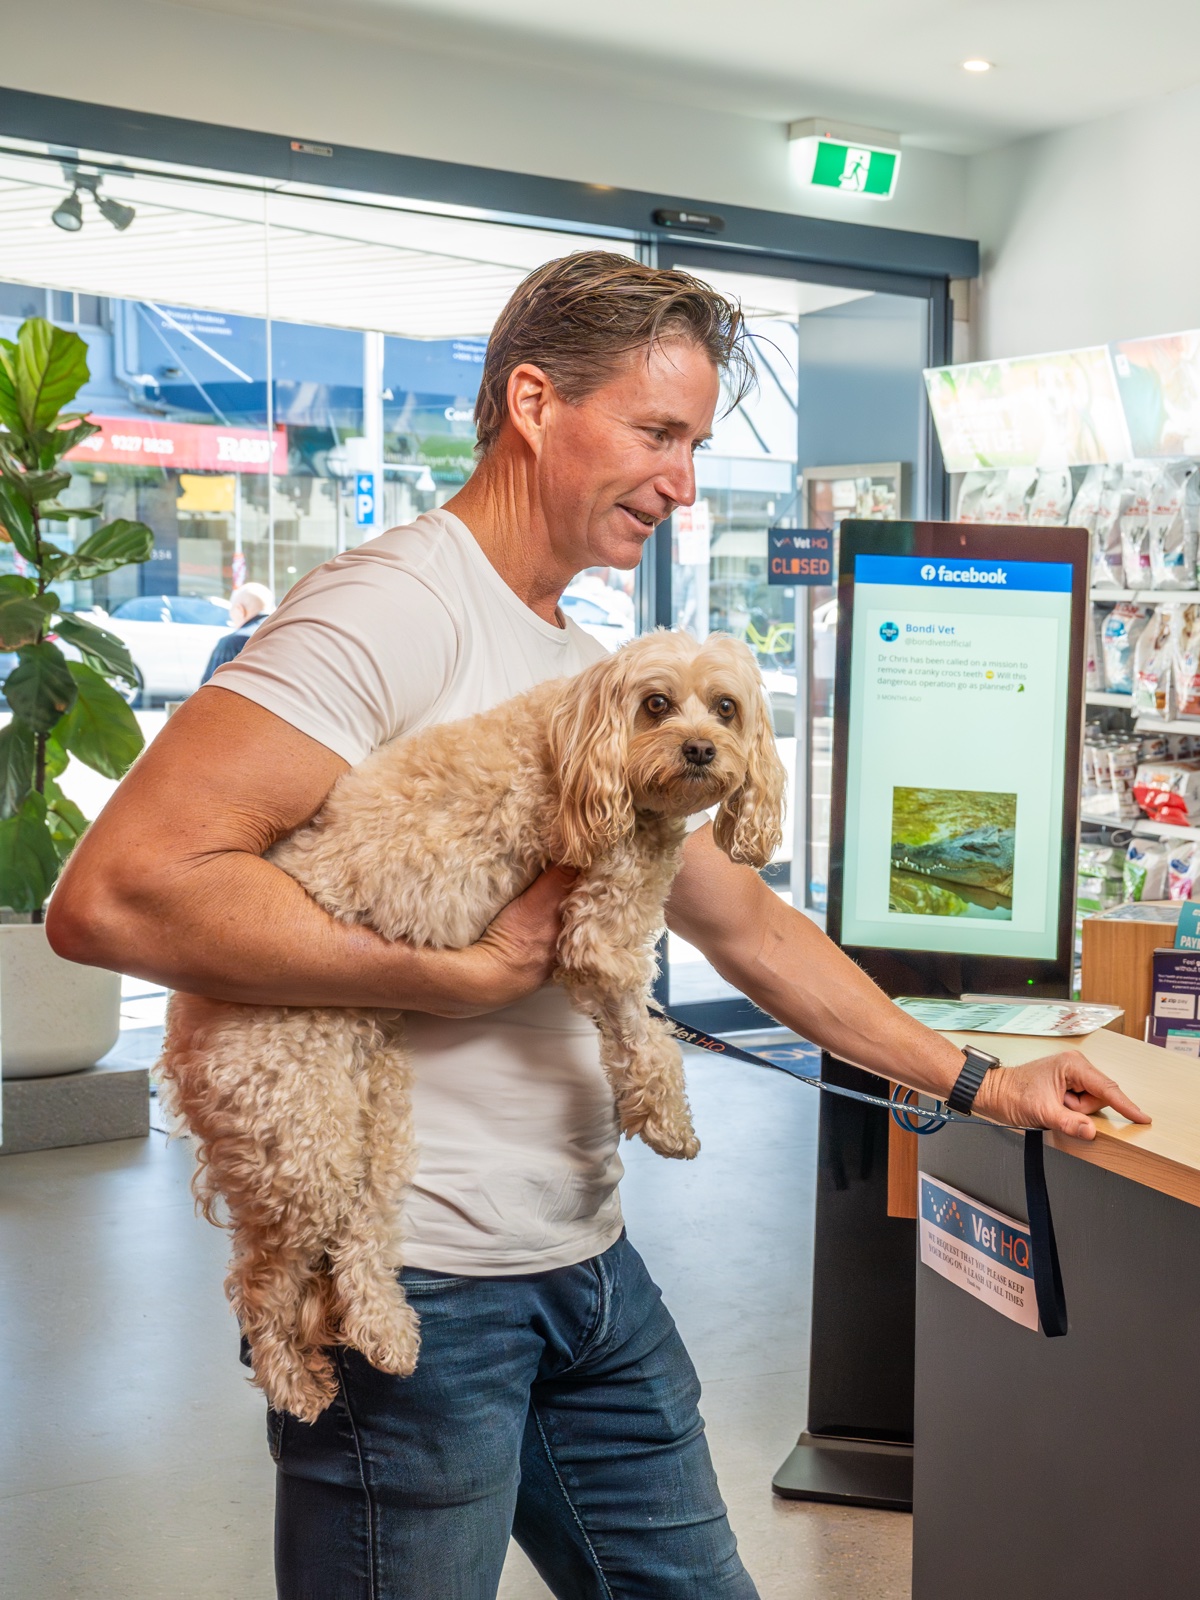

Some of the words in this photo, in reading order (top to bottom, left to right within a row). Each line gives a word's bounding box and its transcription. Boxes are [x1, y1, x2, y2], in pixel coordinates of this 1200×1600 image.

[358, 494, 374, 523] P
[793, 536, 811, 549] Vet
[811, 537, 829, 550] HQ
[937, 565, 1008, 584] facebook
[906, 624, 935, 633] Bondi
[938, 626, 955, 635] Vet
[905, 638, 972, 648] @bondivetofficial
[878, 654, 887, 662] Dr
[889, 655, 909, 663] Chris
[910, 656, 924, 664] has
[925, 656, 945, 665] been
[946, 657, 969, 666] called
[989, 659, 1018, 669] mission
[877, 667, 906, 675] remove
[914, 667, 940, 678] cranky
[941, 669, 961, 677] crocs
[963, 669, 983, 678] teeth
[997, 671, 1011, 679] Will
[1012, 672, 1027, 681] this
[877, 677, 917, 687] dangerous
[919, 679, 956, 689] operation
[957, 682, 967, 691] go
[979, 682, 1014, 692] planned?
[695, 1037, 726, 1052] HQ
[972, 1213, 996, 1253] Vet
[1001, 1230, 1029, 1269] HQ
[928, 1231, 936, 1243] WE
[936, 1237, 959, 1257] REQUEST
[960, 1250, 974, 1265] THAT
[975, 1257, 986, 1273] YOU
[987, 1267, 1007, 1286] PLEASE
[1008, 1279, 1025, 1294] KEEP
[928, 1243, 942, 1259] YOUR
[942, 1253, 954, 1265] DOG
[954, 1259, 962, 1270] ON
[967, 1268, 985, 1285] LEASH
[986, 1280, 992, 1290] AT
[993, 1285, 1004, 1297] ALL
[1005, 1290, 1024, 1308] TIMES
